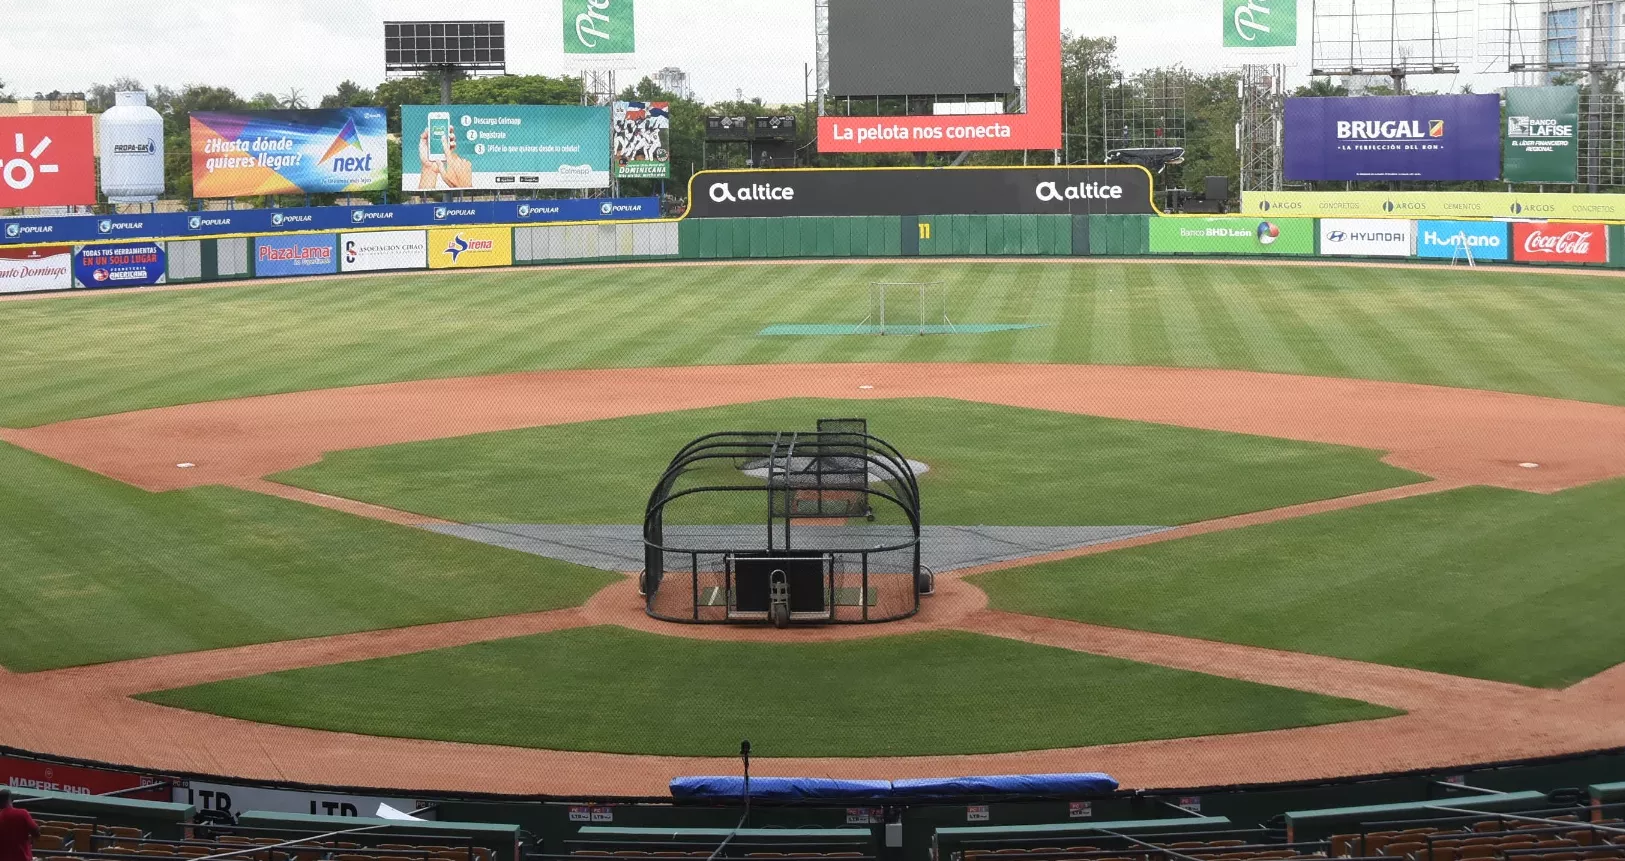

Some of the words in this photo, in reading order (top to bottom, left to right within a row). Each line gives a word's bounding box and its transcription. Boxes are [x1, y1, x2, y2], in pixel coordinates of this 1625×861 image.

[833, 124, 854, 140] La
[857, 123, 909, 144] pelota
[913, 126, 943, 140] nos
[946, 122, 1011, 139] conecta
[1337, 120, 1426, 139] BRUGAL
[1530, 125, 1573, 136] LAFISE
[204, 139, 249, 154] ¿Hasta
[252, 136, 293, 152] dónde
[206, 157, 257, 173] quieres
[258, 154, 301, 171] llegar?
[333, 155, 372, 173] next
[619, 166, 666, 174] DOMINICANA
[737, 183, 794, 201] altice
[1065, 182, 1123, 199] altice
[529, 206, 559, 214] POPULAR
[612, 204, 642, 212] POPULAR
[1443, 202, 1481, 210] CEMENTOS
[1524, 204, 1555, 212] ARGOS
[1572, 205, 1615, 213] CONCRETOS
[363, 212, 393, 222] POPULAR
[446, 208, 476, 217] POPULAR
[201, 218, 230, 227] POPULAR
[284, 214, 312, 223] POPULAR
[19, 225, 53, 233] POPULAR
[111, 221, 143, 231] POPULAR
[918, 223, 930, 239] 11
[1180, 228, 1205, 237] Banco
[1205, 228, 1228, 237] BHD
[1228, 227, 1252, 237] León
[1350, 233, 1405, 242] HYUNDAI
[1424, 230, 1501, 247] Humano
[83, 249, 101, 257] TODAS
[114, 247, 157, 256] HERRAMIENTAS
[83, 257, 94, 266] EN
[96, 256, 107, 265] UN
[110, 255, 129, 265] SOLO
[132, 254, 157, 264] LUGAR
[20, 265, 67, 280] Domingo
